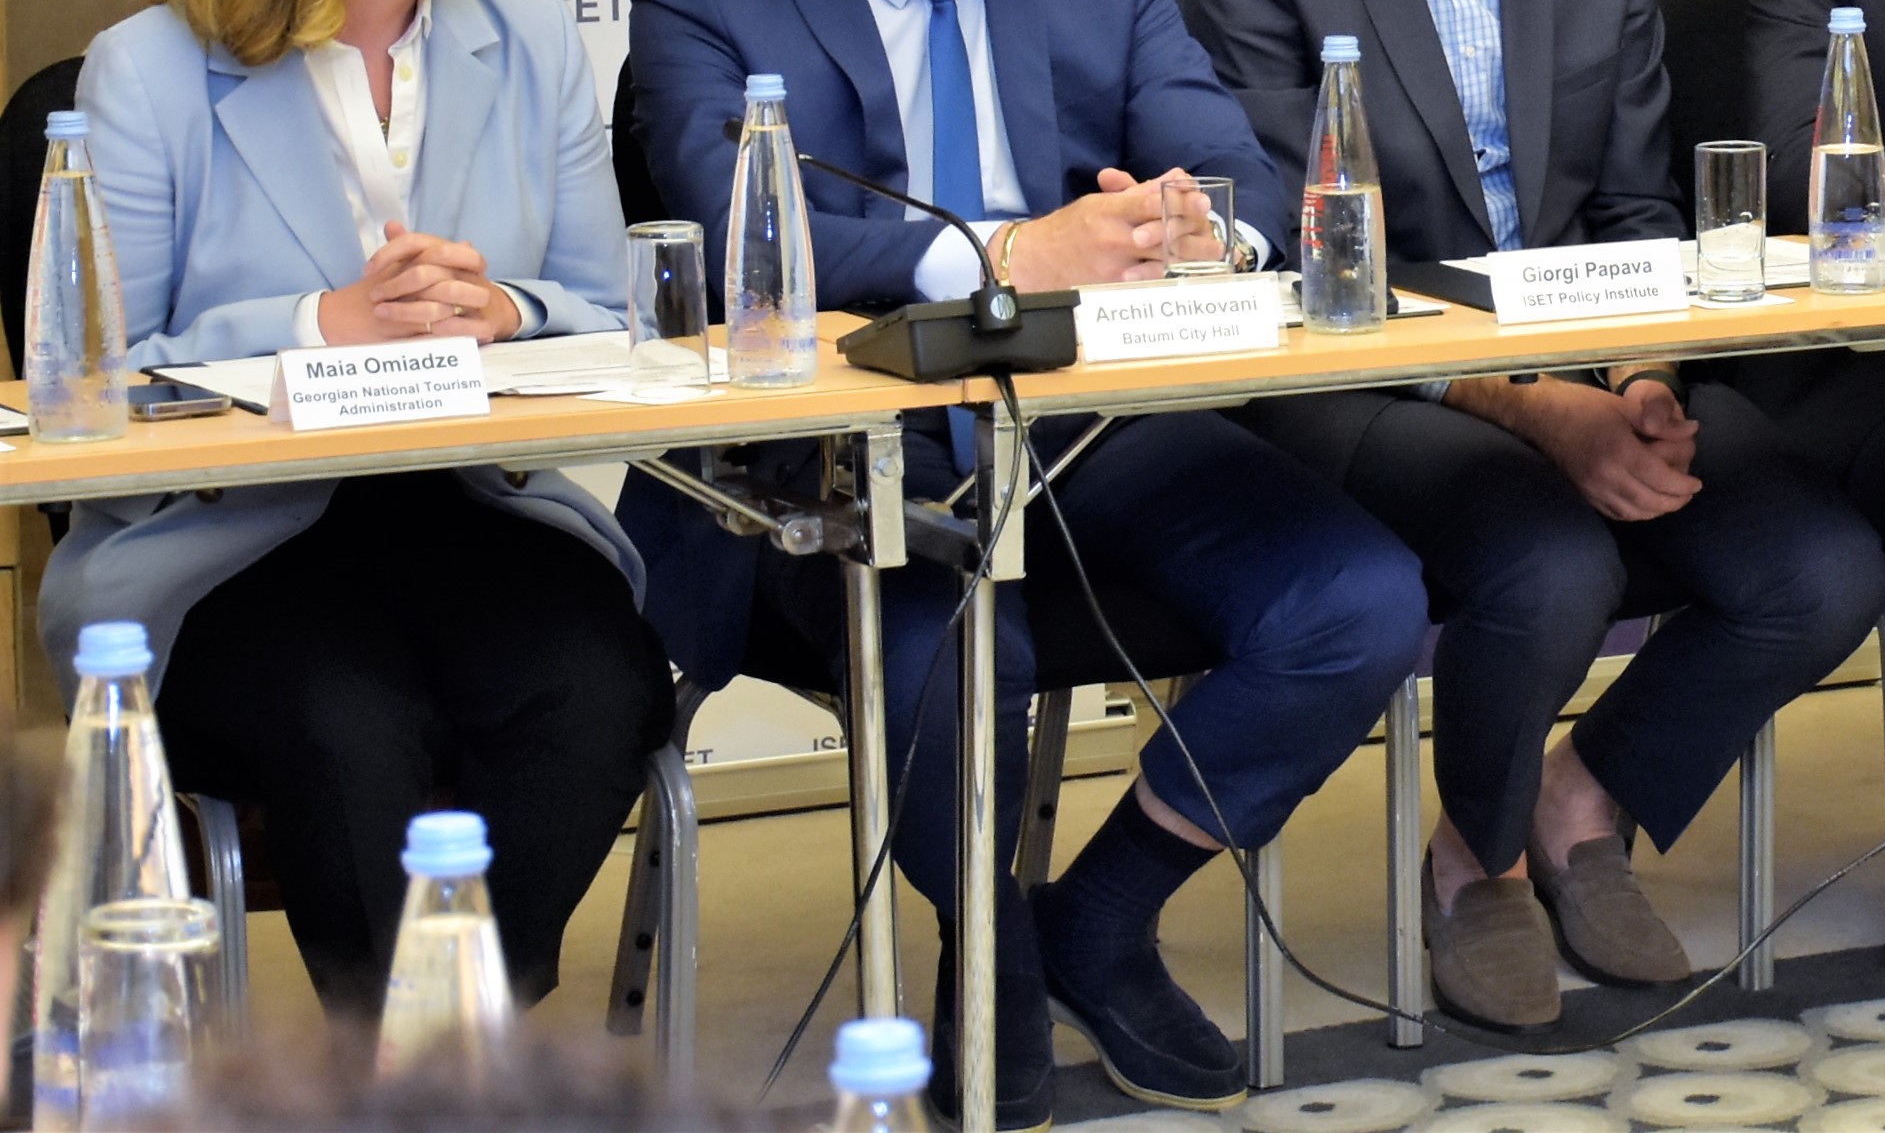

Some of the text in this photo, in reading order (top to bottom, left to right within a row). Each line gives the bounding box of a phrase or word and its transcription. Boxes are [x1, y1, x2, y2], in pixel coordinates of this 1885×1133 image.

[1522, 260, 1653, 284] Giorgi Papava
[1096, 295, 1258, 322] Archil Chikovani
[1523, 286, 1659, 307] ISET Policy Institute
[1122, 324, 1240, 345] Batumi City Hall
[306, 353, 459, 379] Maia Omiadze
[293, 378, 482, 404] Georgian National Tourism
[339, 398, 443, 417] Administration
